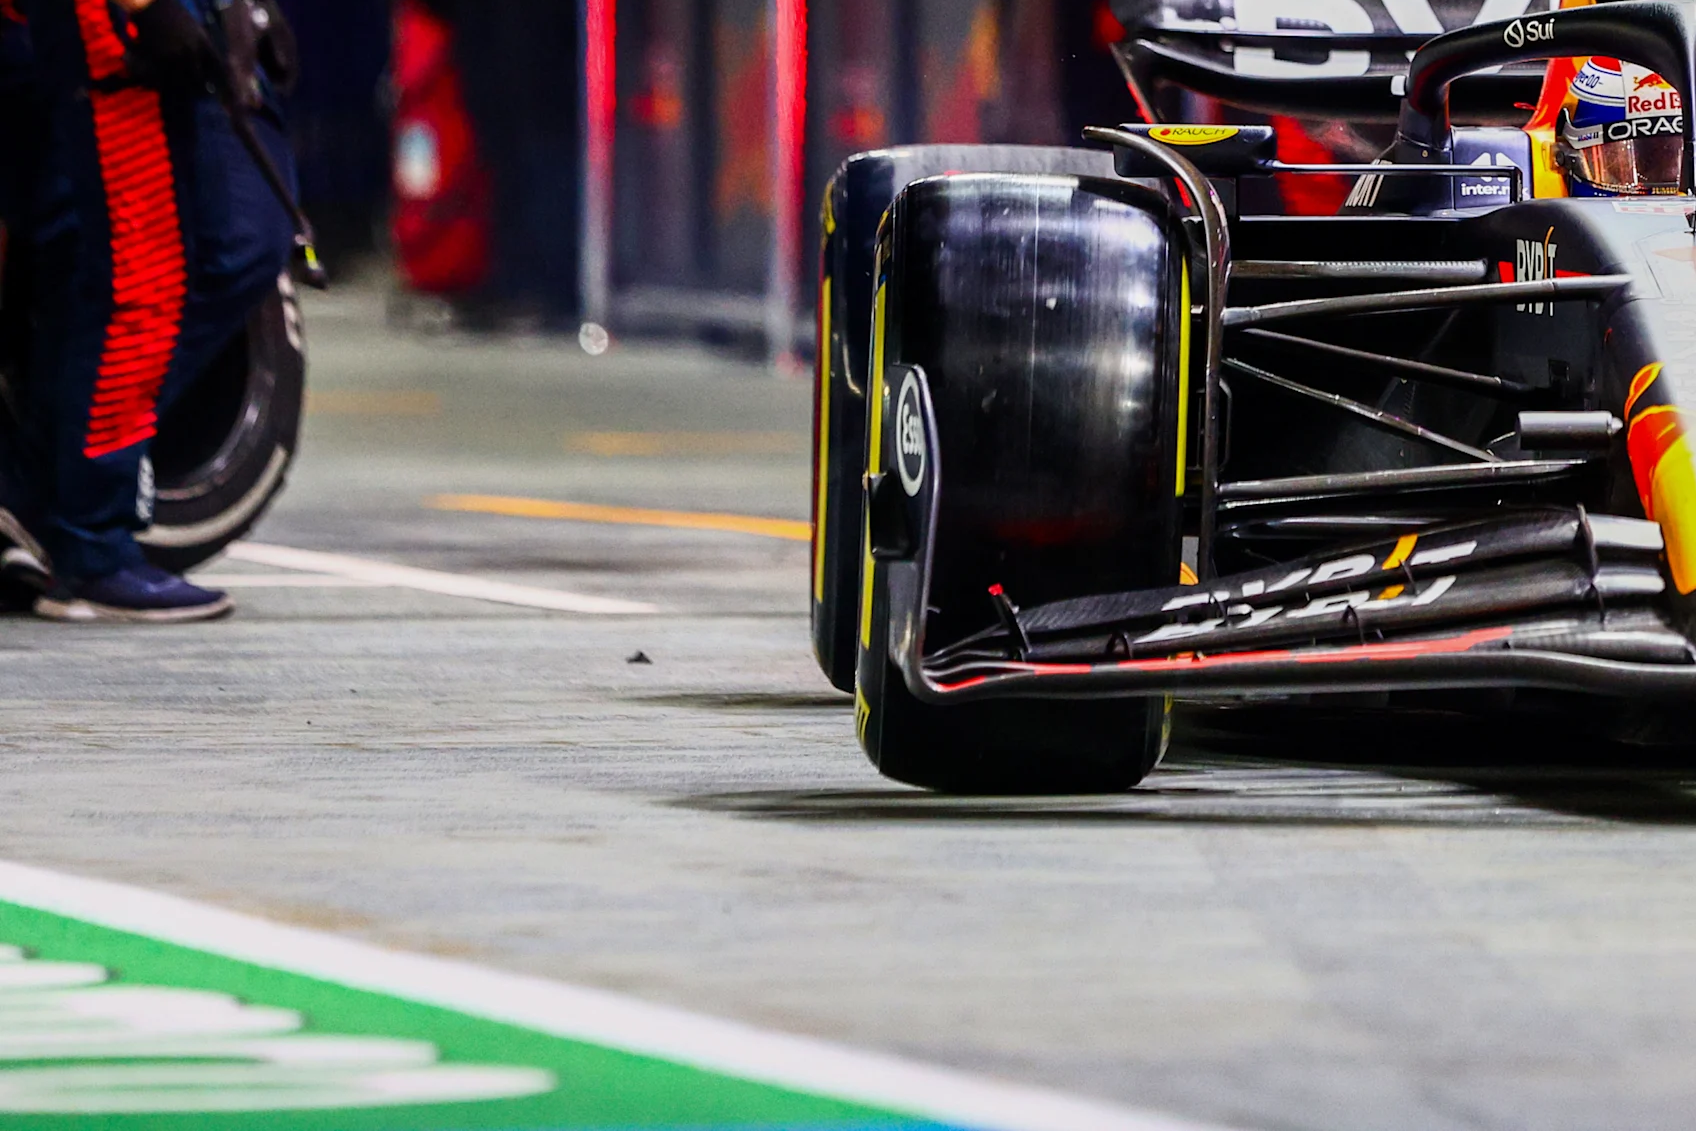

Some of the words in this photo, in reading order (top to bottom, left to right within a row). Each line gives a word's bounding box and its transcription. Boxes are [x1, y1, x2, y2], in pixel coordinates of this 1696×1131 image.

[1526, 18, 1555, 41] Sui
[1627, 91, 1665, 114] Red
[1172, 127, 1227, 136] RAUCH
